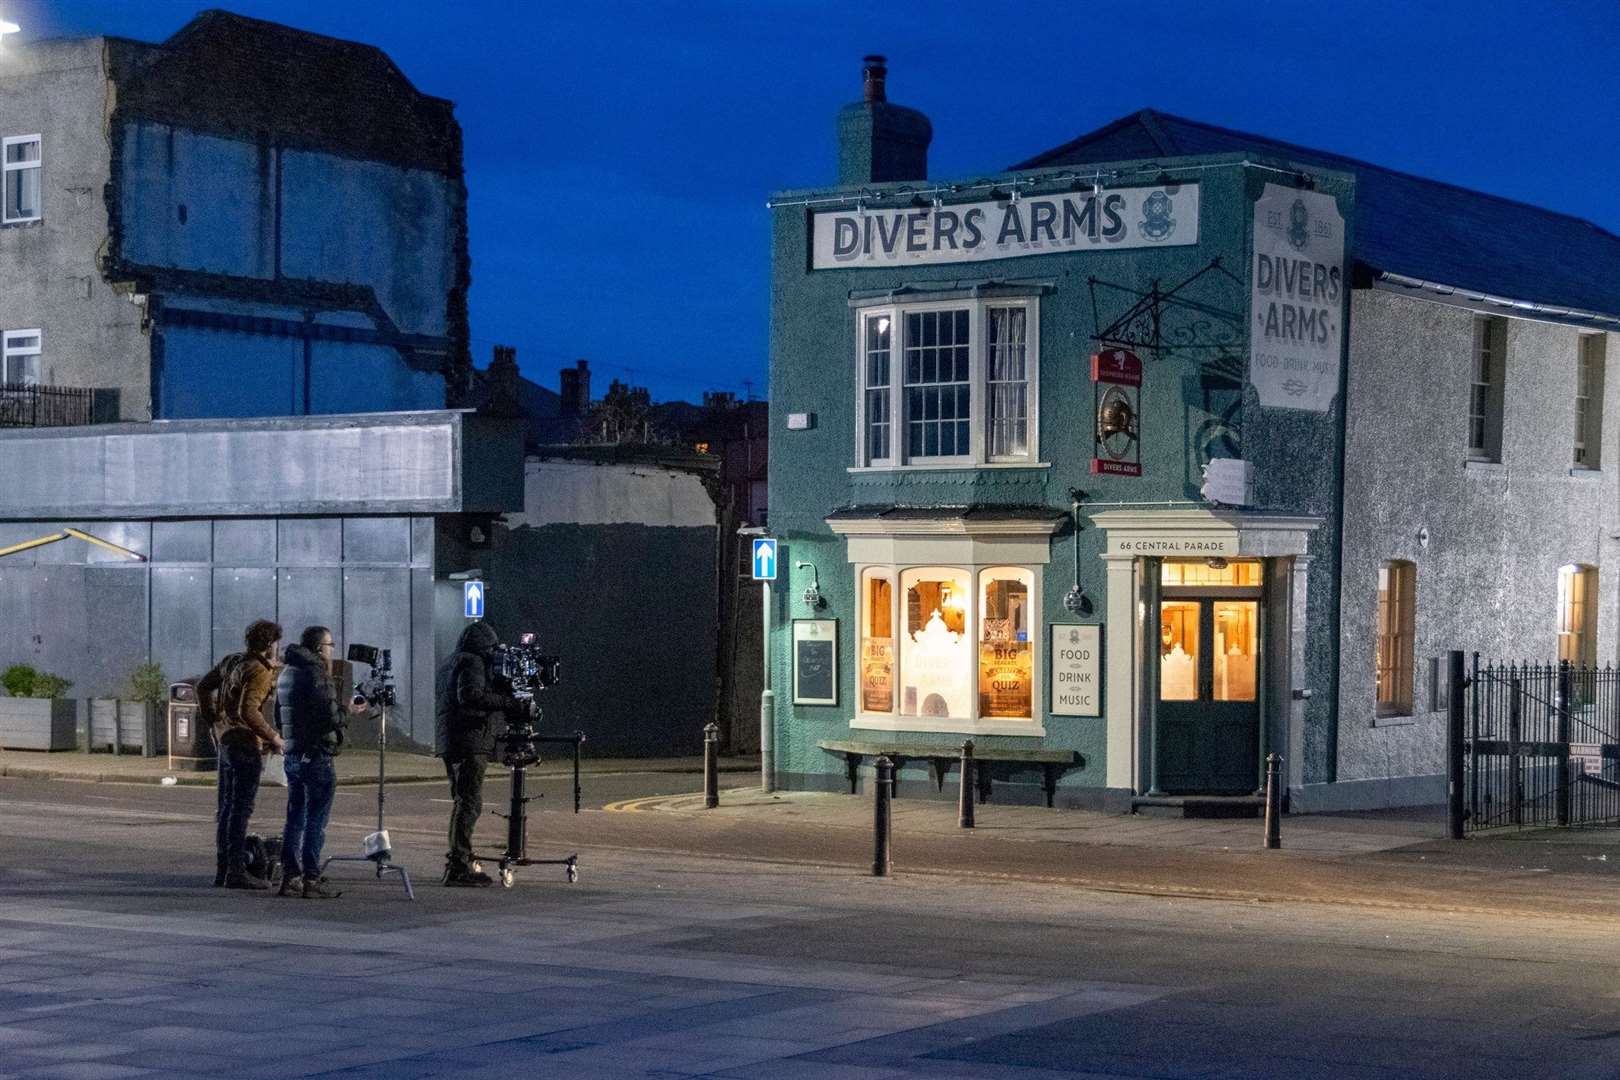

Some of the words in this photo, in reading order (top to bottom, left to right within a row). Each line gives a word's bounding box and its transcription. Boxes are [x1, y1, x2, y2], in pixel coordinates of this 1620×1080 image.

[834, 207, 982, 256] DIVERS
[996, 194, 1124, 244] ARMS
[1257, 253, 1340, 301] DIVERS
[1263, 302, 1329, 344] ARMS
[1255, 353, 1279, 369] FOOD
[1103, 463, 1122, 472] DIVERS
[1120, 542, 1131, 550] 66
[1135, 541, 1180, 551] CENTRAL
[1184, 542, 1225, 551] PARADE
[870, 645, 885, 657] BIG
[994, 648, 1018, 660] BIG
[1060, 649, 1090, 660] FOOD
[869, 676, 887, 688] QUIZ
[1059, 672, 1092, 683] DRINK
[992, 680, 1020, 692] QUIZ
[1059, 695, 1091, 706] MUSIC
